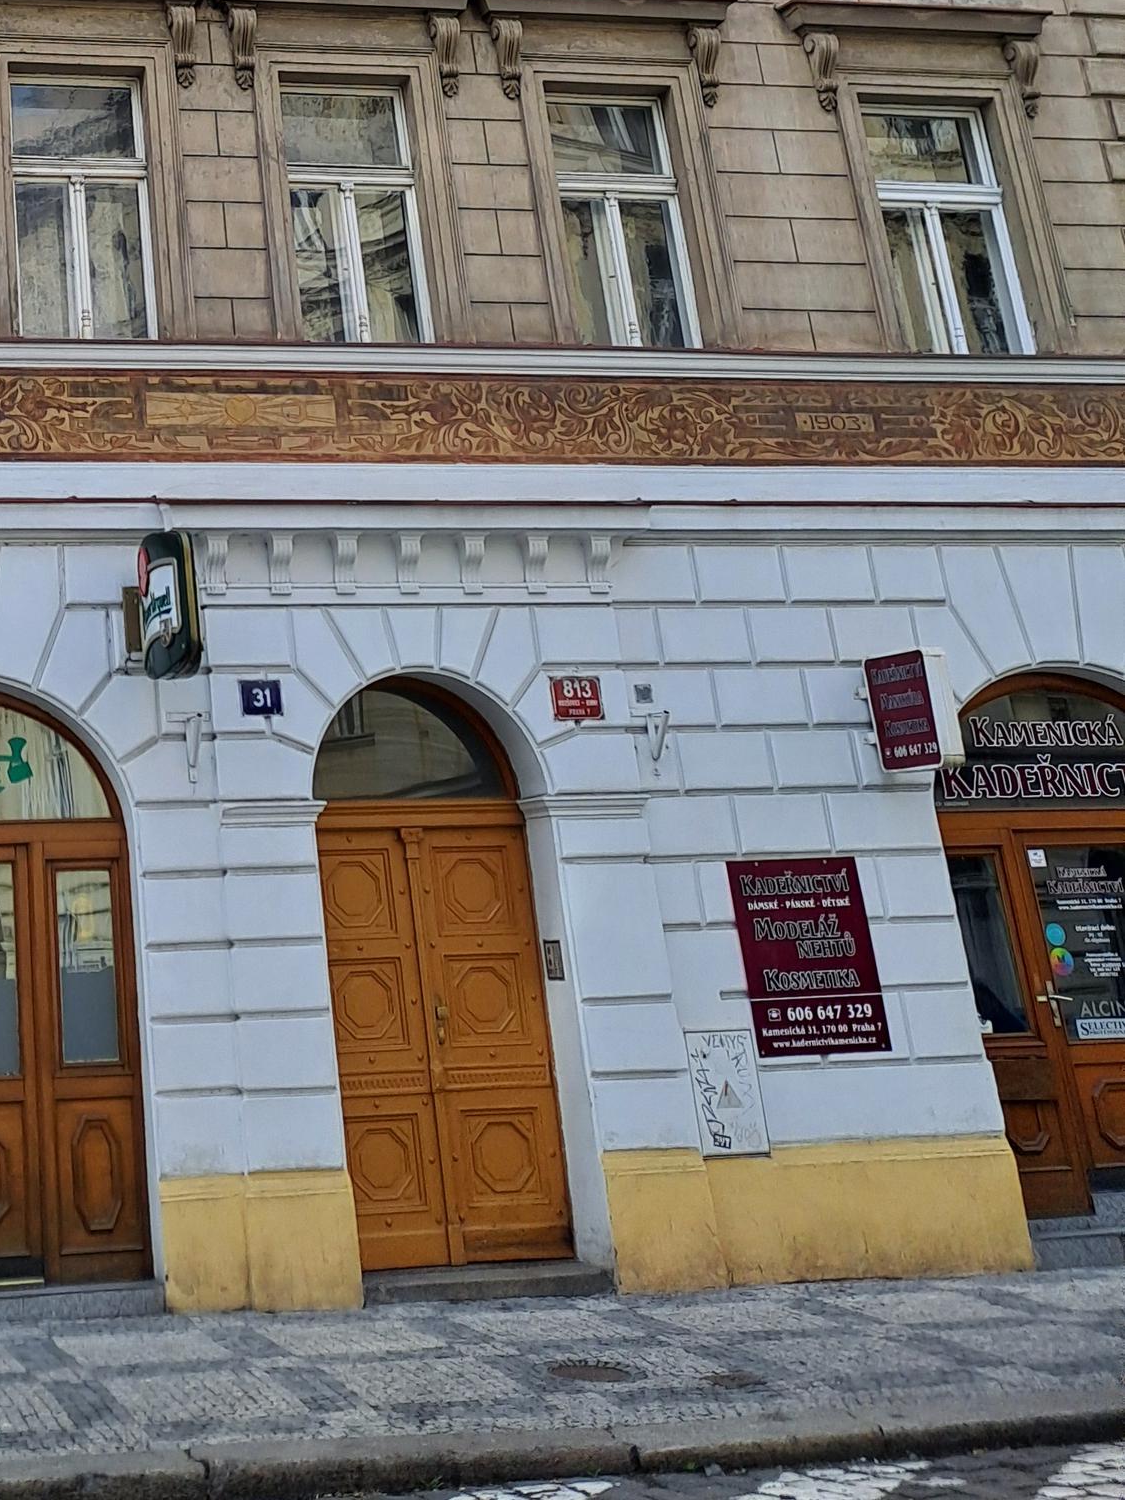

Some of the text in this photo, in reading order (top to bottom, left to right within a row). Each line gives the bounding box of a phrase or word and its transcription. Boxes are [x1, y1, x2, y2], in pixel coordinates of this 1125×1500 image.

[251, 687, 272, 708] 31
[562, 680, 592, 698] 813
[969, 714, 1124, 748] KAMENICKÁ
[893, 741, 939, 758] 606 647 329
[739, 868, 850, 897] KADEŘNICTVÍ
[747, 899, 780, 911] DÁMSKÉ
[785, 898, 816, 910] PÁNSKÉ
[822, 896, 851, 908] DĚTSKÉ
[753, 913, 841, 942] MODELÁŽ
[796, 931, 856, 959] NEHTŮ
[763, 968, 861, 991] KOSMETIKA
[787, 1003, 873, 1021] 606 647 329
[762, 1025, 806, 1037] Kamenická
[822, 1024, 837, 1034] 170
[838, 1023, 849, 1033] 00
[852, 1022, 876, 1032] Praha
[877, 1022, 882, 1031] 7
